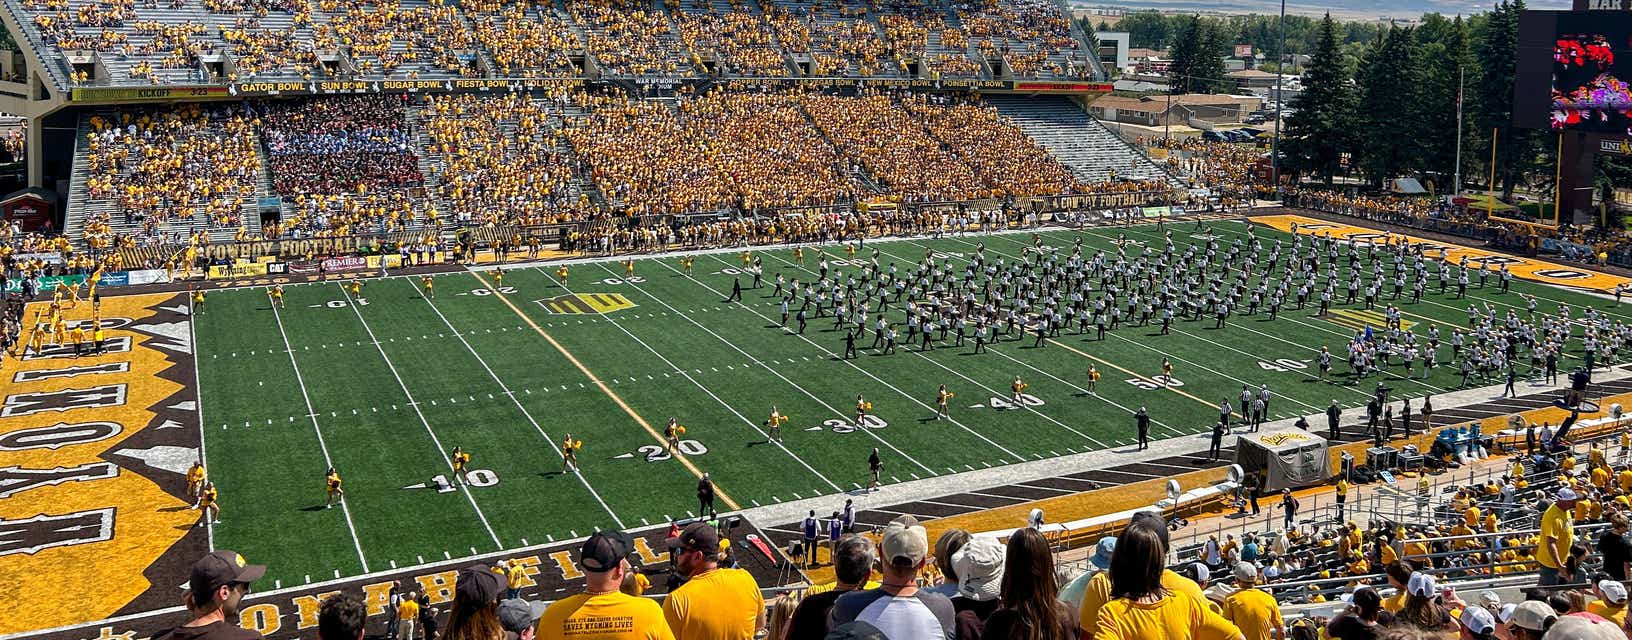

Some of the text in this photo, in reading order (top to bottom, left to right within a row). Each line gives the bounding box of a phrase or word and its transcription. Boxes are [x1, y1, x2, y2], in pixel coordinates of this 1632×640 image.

[241, 83, 274, 92] GATOR
[278, 82, 305, 91] BOWL
[321, 82, 369, 90] SUN BOWL
[383, 81, 443, 89] SUGAR BOWL
[456, 80, 511, 88] FIESTA BOWL
[562, 79, 585, 87] BOWL
[984, 80, 1005, 88] BOWL
[138, 88, 170, 98] KICKOFF
[269, 263, 285, 273] CAT
[1257, 358, 1308, 372] 40
[637, 438, 709, 462] 20
[431, 468, 501, 494] 10
[563, 621, 633, 631] SAVES WYOMING LIVES
